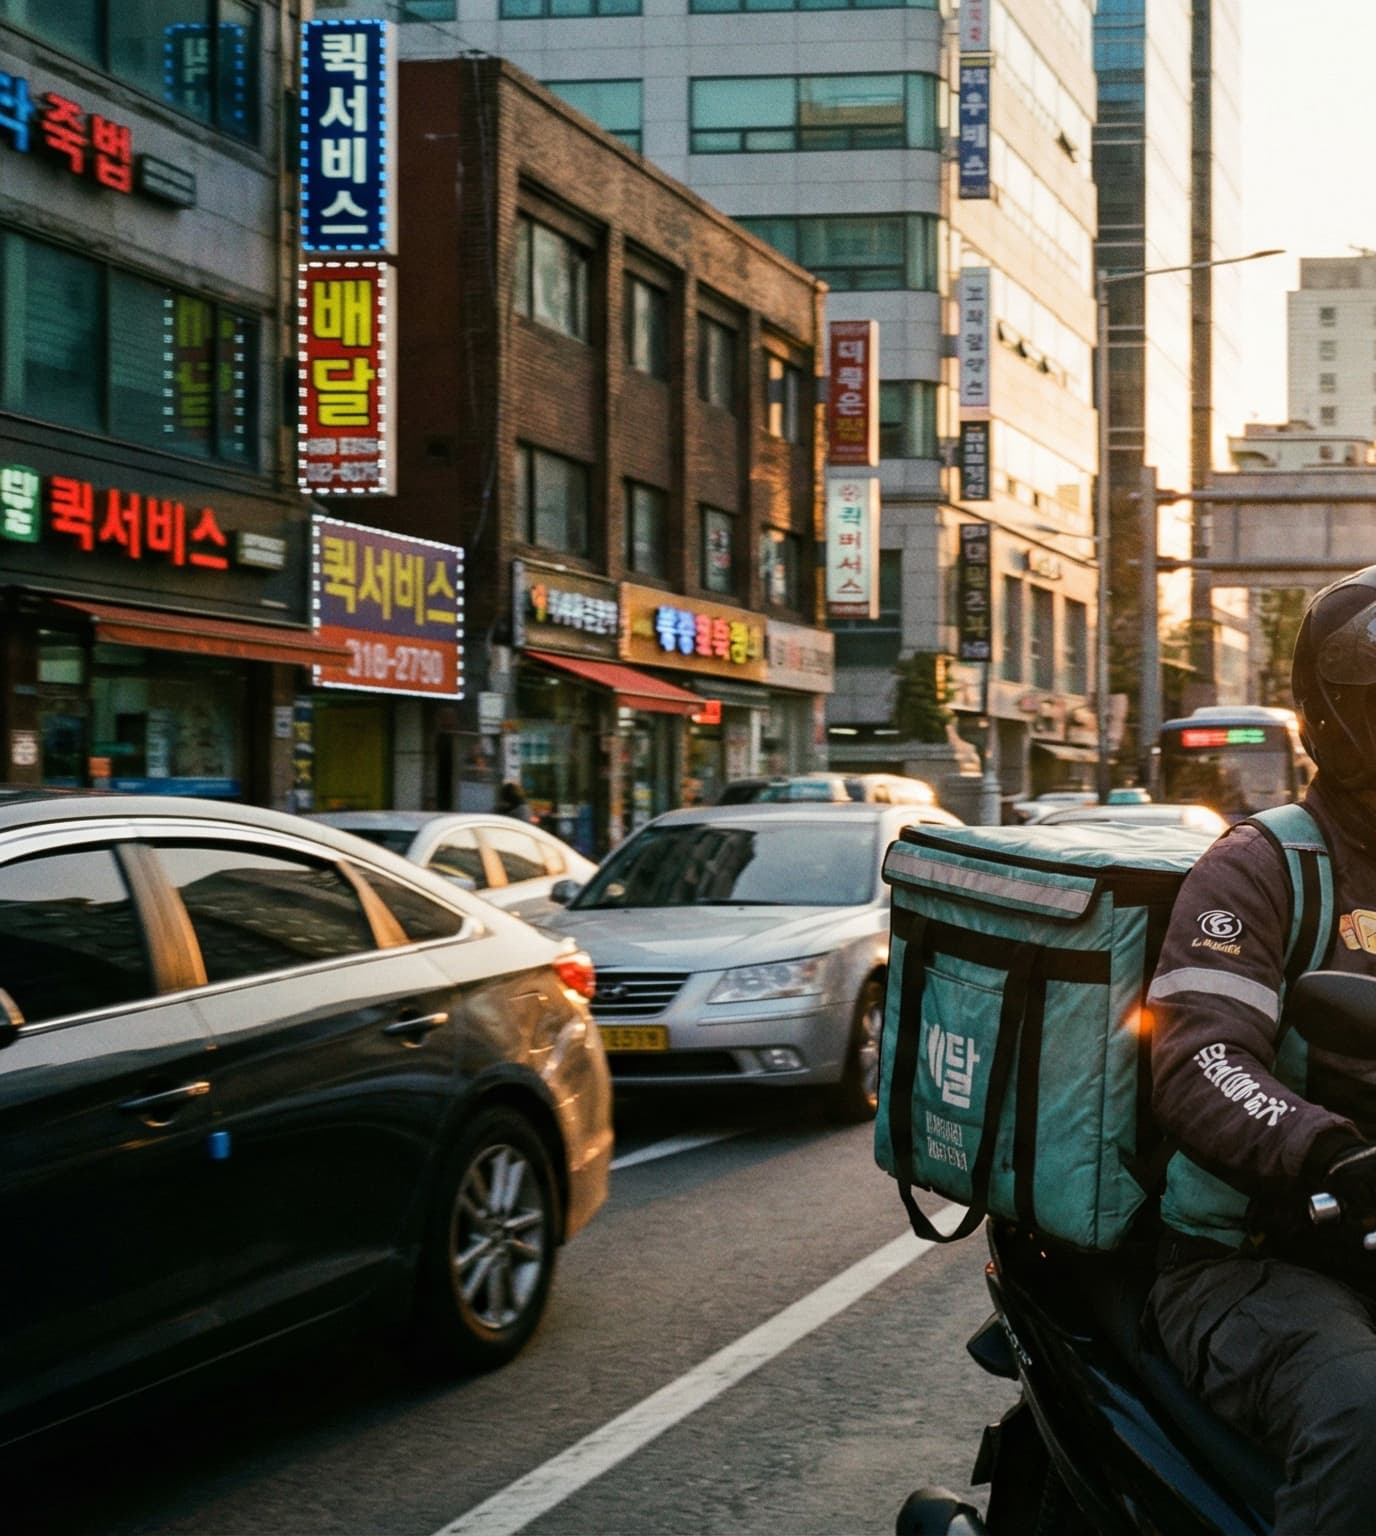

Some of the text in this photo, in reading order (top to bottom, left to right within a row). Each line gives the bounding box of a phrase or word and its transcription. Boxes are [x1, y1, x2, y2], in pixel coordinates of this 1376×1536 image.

[320, 33, 368, 234] 퀵서비스
[312, 280, 376, 426] 배달
[50, 475, 228, 570] 퀵서비스
[322, 536, 457, 626] 퀵서비스
